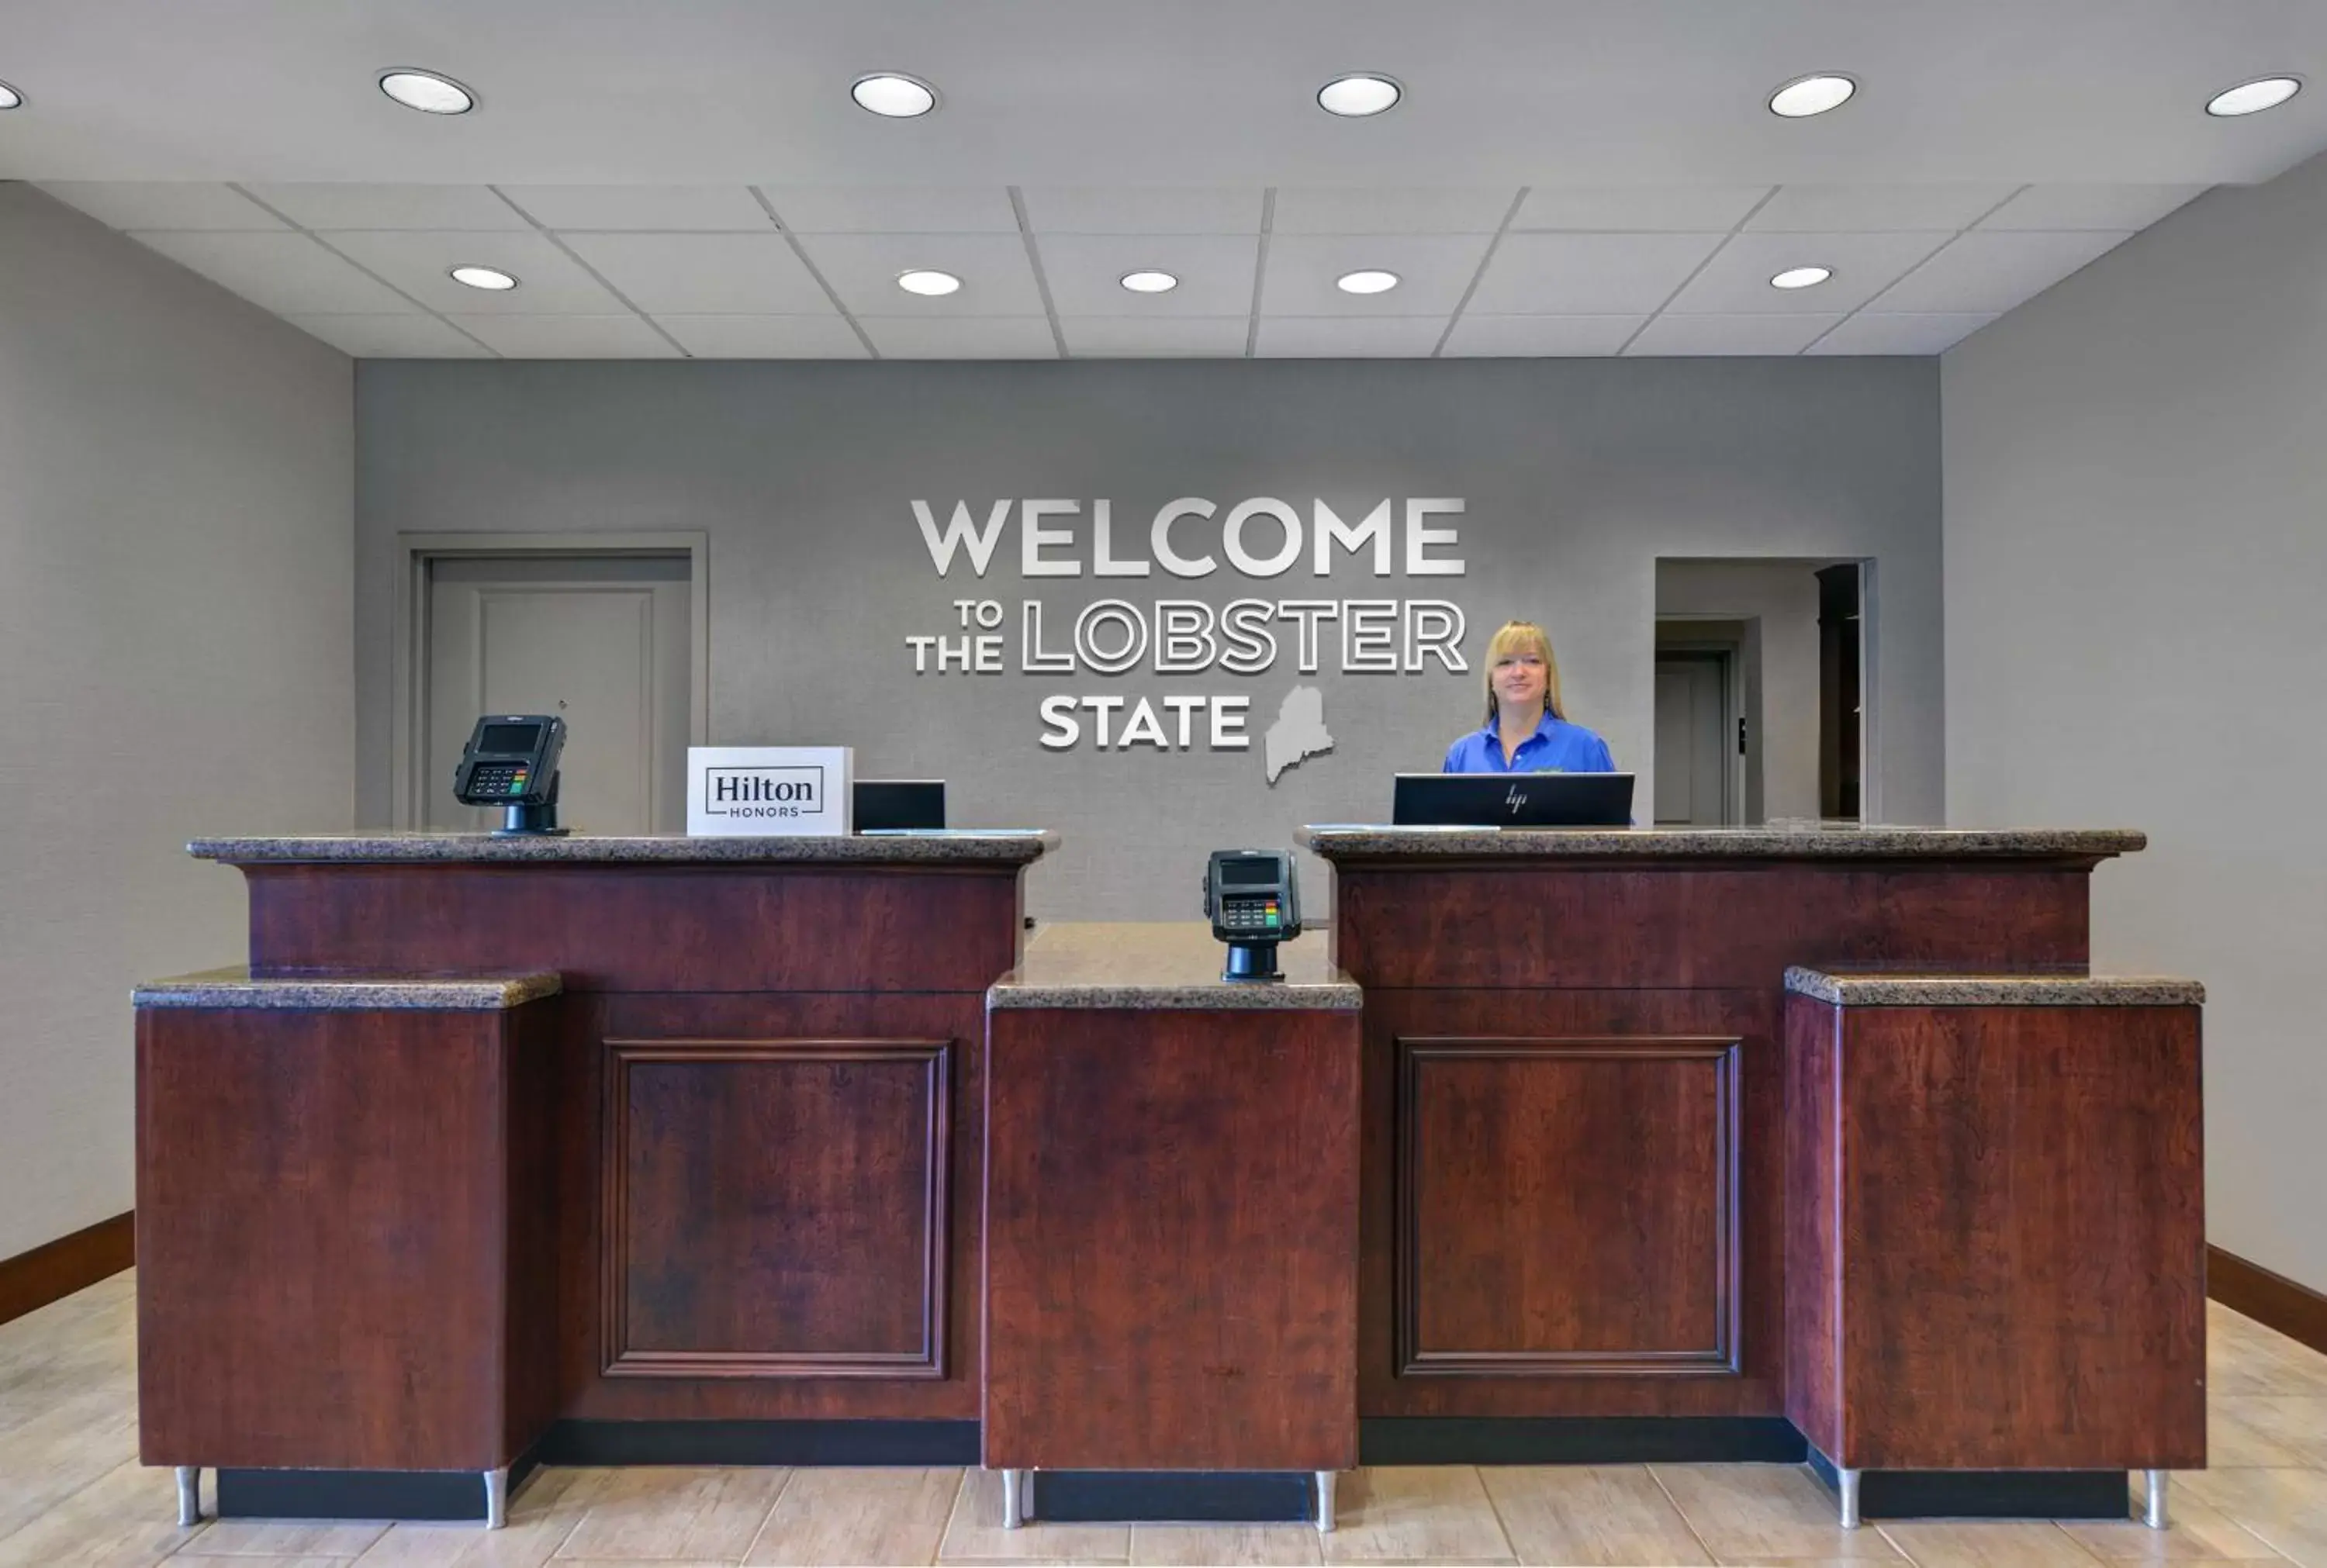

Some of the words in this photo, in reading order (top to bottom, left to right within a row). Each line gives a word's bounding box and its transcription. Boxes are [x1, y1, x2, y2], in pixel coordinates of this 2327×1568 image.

[911, 497, 1465, 577] WELCOME
[954, 599, 1004, 628] TO
[906, 635, 1003, 672] THE
[1022, 598, 1468, 673] LOBSTER
[1039, 695, 1250, 748] STATE
[717, 776, 812, 801] Hilton
[730, 807, 799, 817] HONORS
